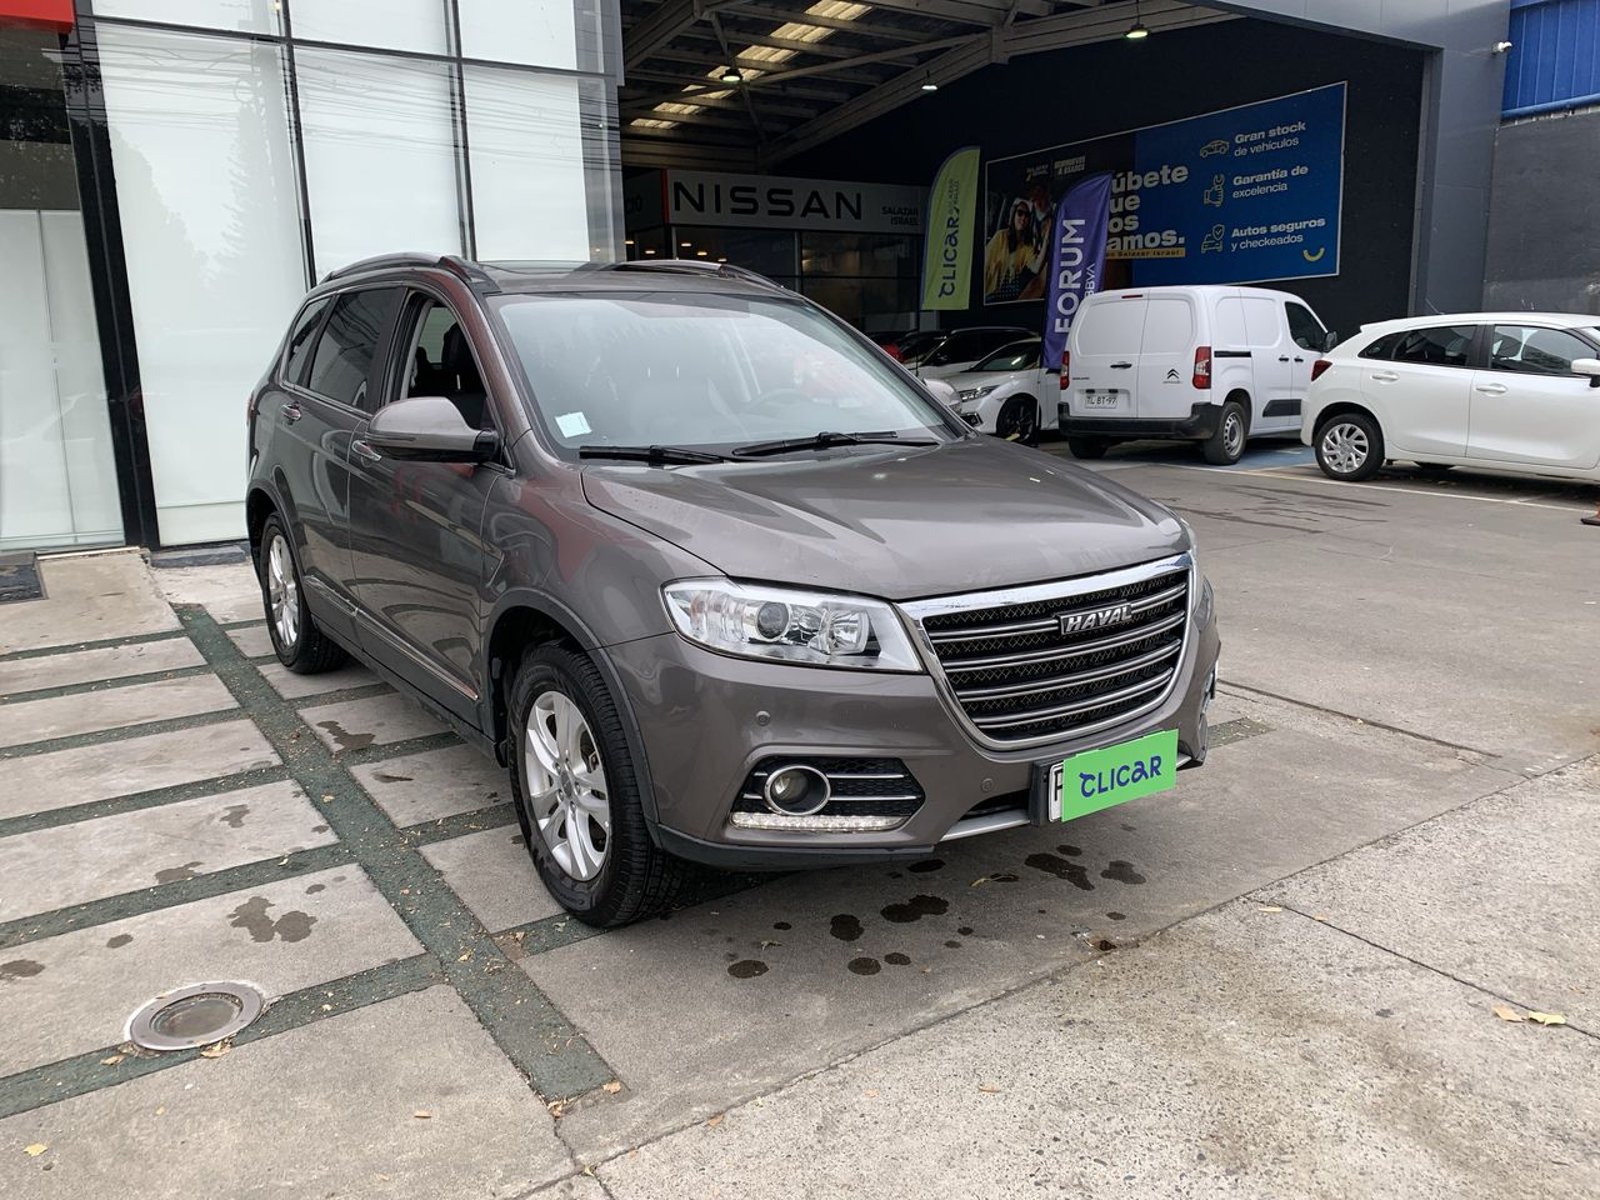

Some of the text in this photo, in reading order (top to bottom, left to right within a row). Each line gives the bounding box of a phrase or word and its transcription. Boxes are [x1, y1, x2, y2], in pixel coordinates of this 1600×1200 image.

[1234, 120, 1307, 144] Gran stock
[1234, 136, 1300, 157] de vehículos
[1111, 164, 1189, 194] úbete
[1233, 165, 1309, 186] Garantía de
[673, 181, 862, 221] NISSAN
[1232, 182, 1288, 199] excelencia
[1109, 194, 1141, 214] ue
[1108, 214, 1140, 233] os
[1231, 217, 1326, 238] Autos seguros
[1106, 229, 1185, 250] amos.
[1230, 233, 1304, 252] y checkeados
[1054, 218, 1086, 334] FORUM
[1065, 604, 1132, 632] HAVAL
